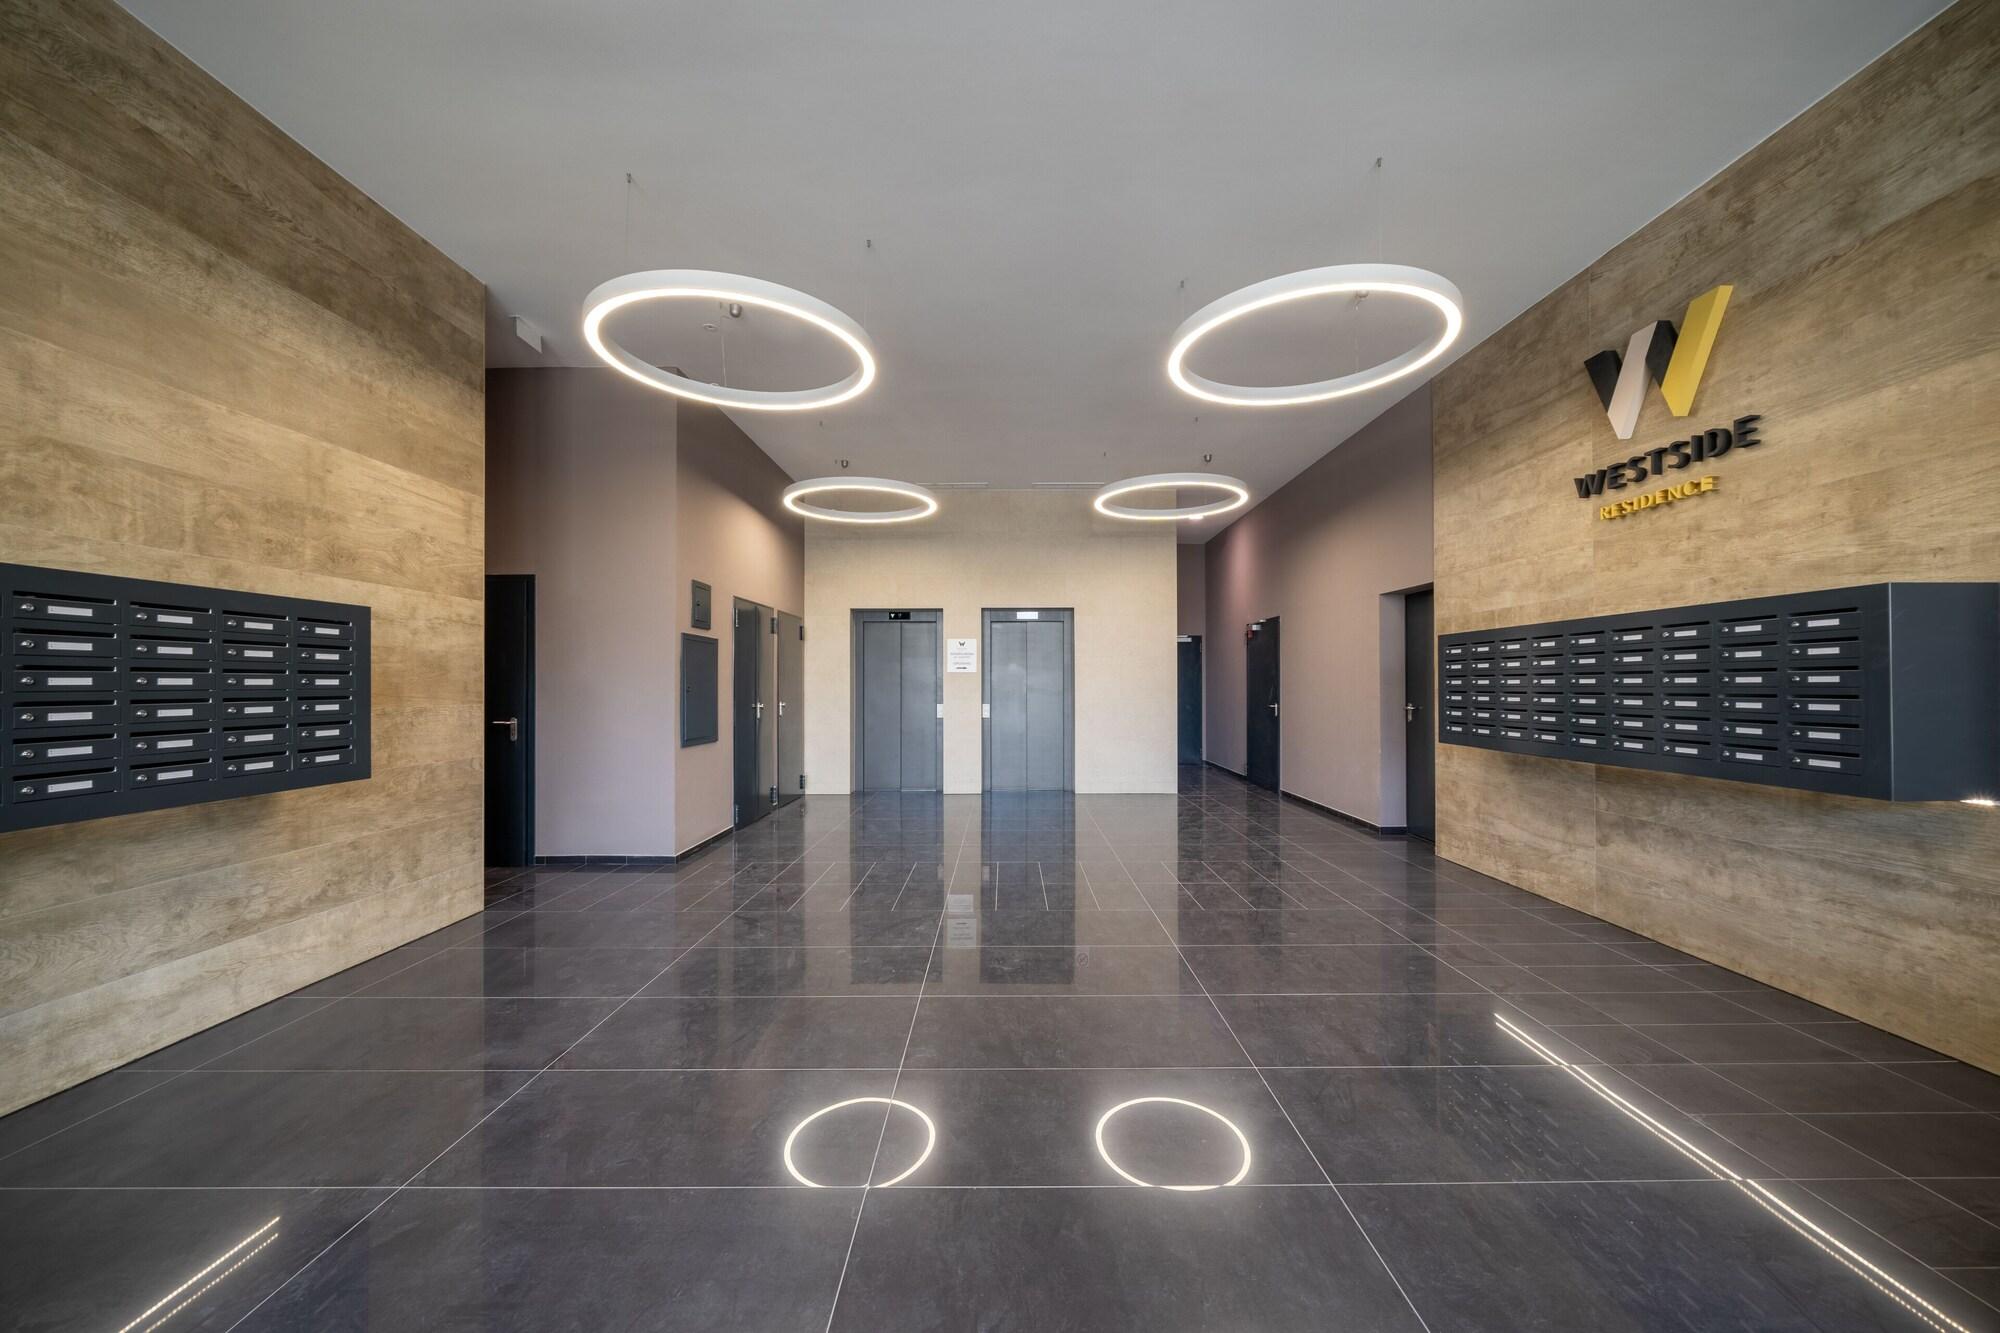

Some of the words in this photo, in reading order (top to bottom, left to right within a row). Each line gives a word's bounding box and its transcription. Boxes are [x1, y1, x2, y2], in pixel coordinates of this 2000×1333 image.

[1584, 285, 1734, 439] W
[1574, 415, 1761, 498] WESTSIDE
[1600, 476, 1719, 521] RESIDENCE
